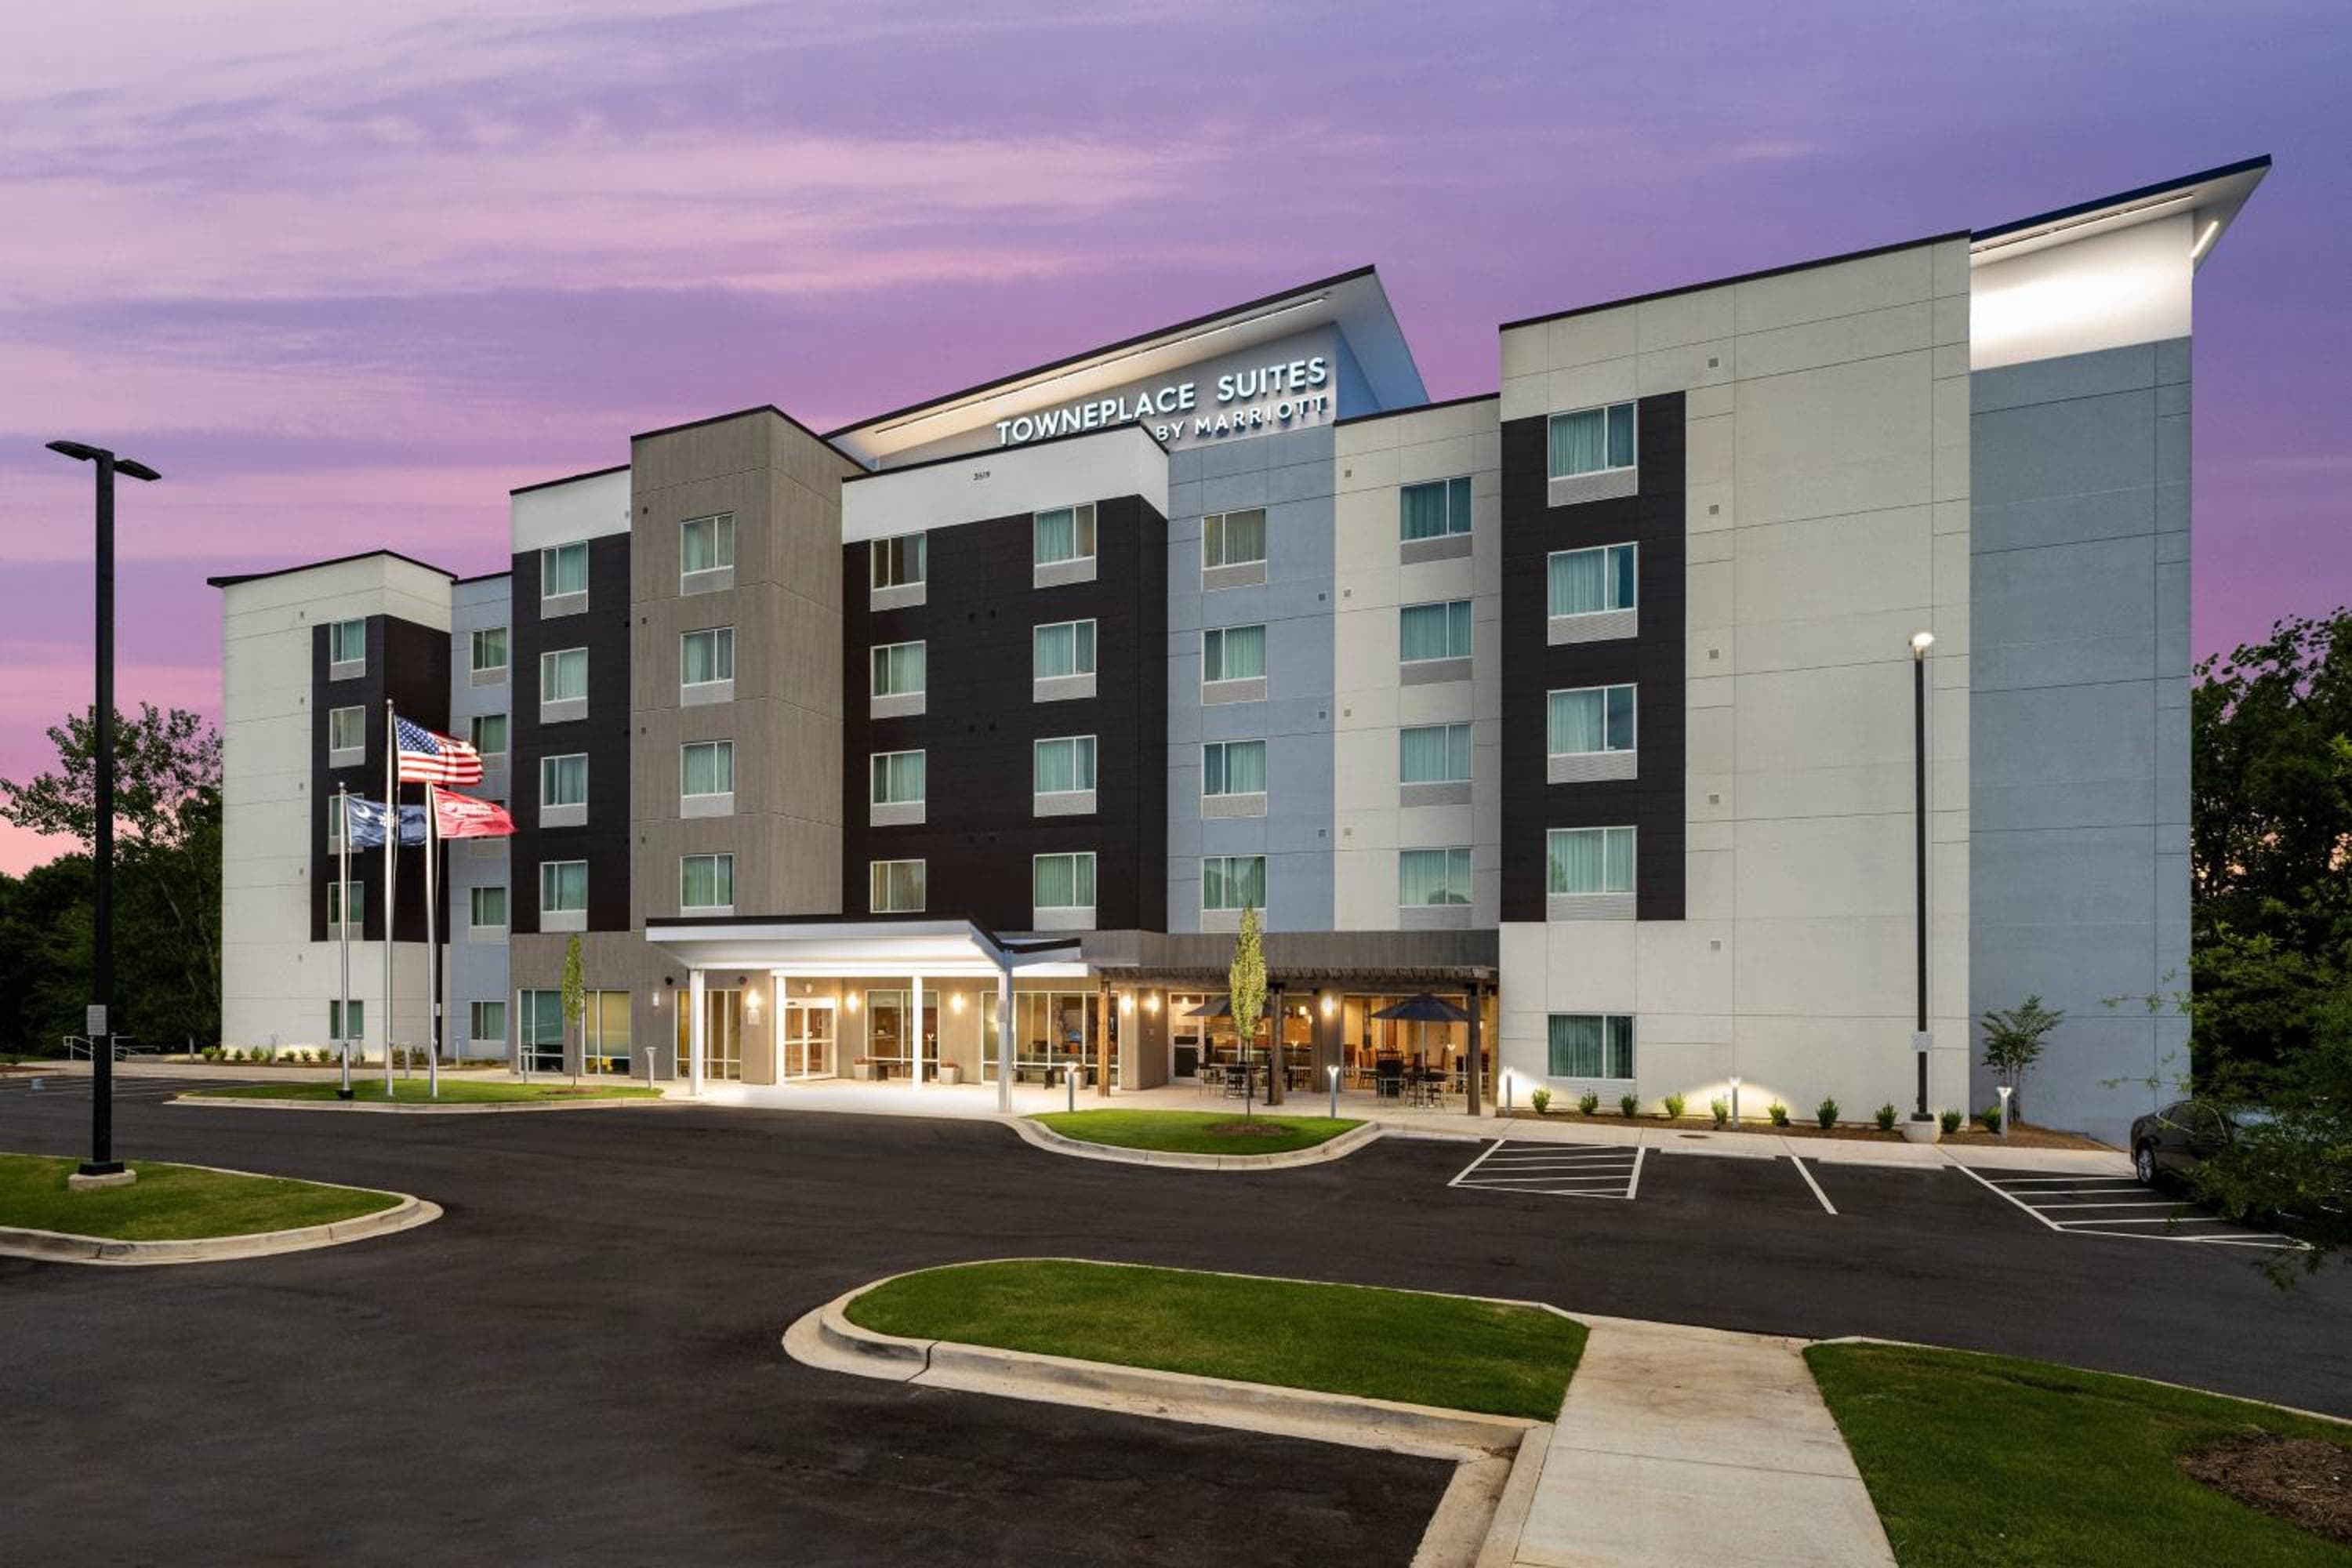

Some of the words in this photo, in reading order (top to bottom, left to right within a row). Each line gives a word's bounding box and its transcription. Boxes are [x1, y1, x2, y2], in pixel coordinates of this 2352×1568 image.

[996, 383, 1196, 444] TOWNEPLACE
[1217, 358, 1327, 401] SUITES
[1156, 421, 1185, 441] BY
[1196, 395, 1326, 435] MARRIOTT
